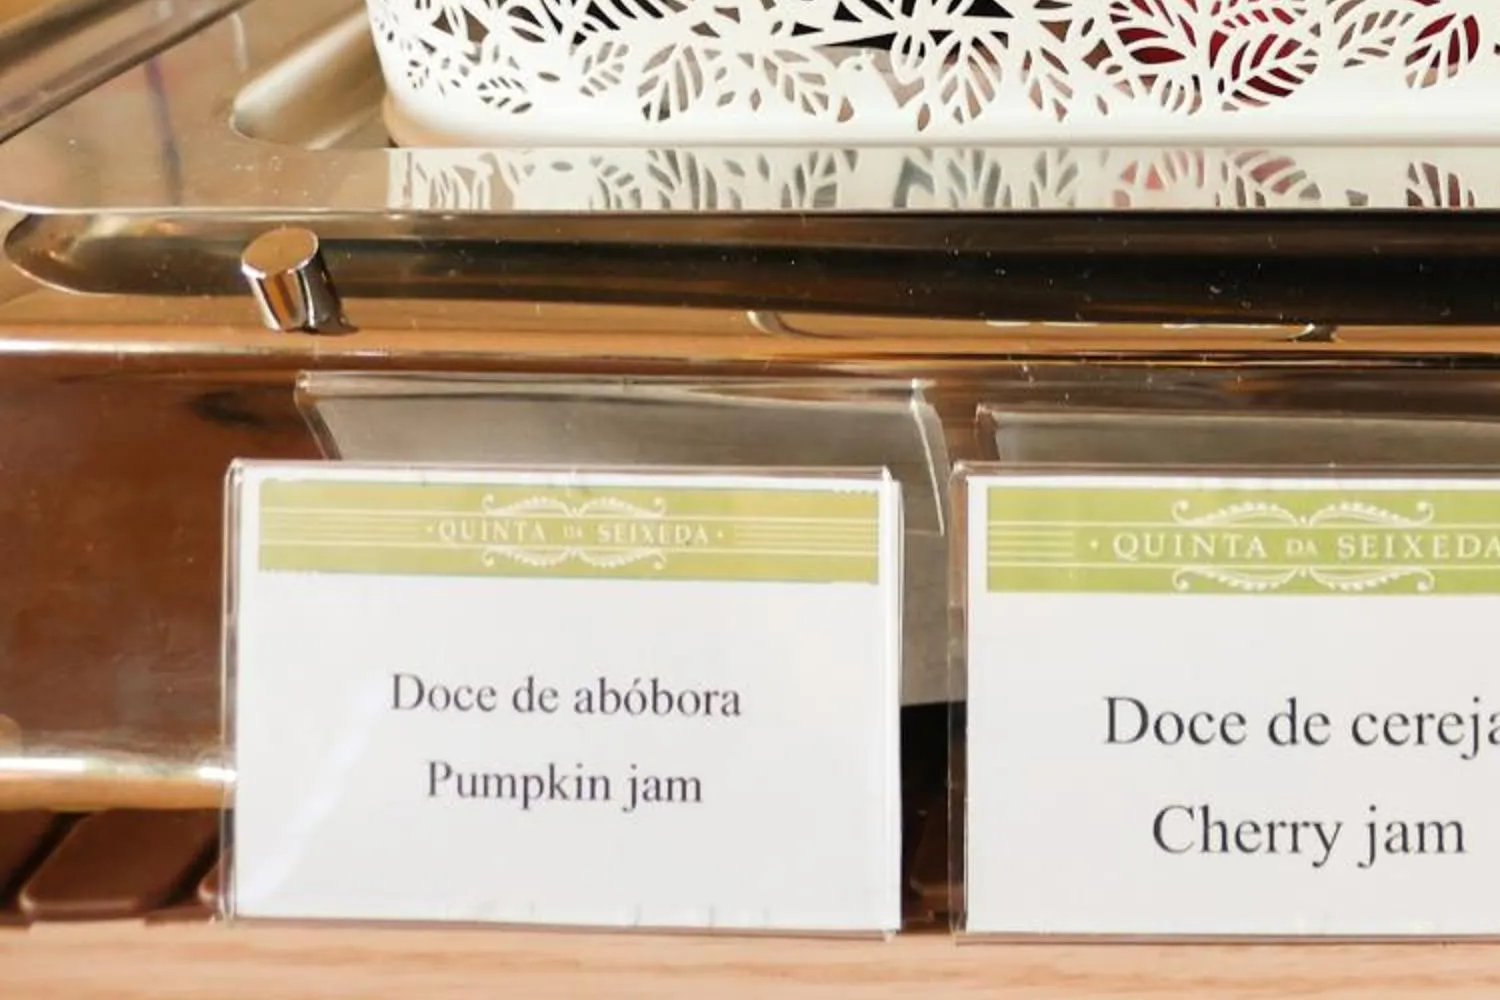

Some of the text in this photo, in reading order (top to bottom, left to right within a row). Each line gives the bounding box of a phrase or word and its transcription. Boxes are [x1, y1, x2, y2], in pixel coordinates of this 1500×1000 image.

[438, 519, 546, 542] QUINTA
[597, 522, 709, 544] SEIXEDA
[1112, 534, 1269, 561] QUINTA
[1285, 537, 1318, 556] DA
[390, 673, 743, 719] Doce de abóbora
[1103, 695, 1248, 748] Doce
[1266, 696, 1332, 748] de
[426, 759, 703, 813] Pumpkin jam
[1151, 803, 1467, 870] Cherry jam
